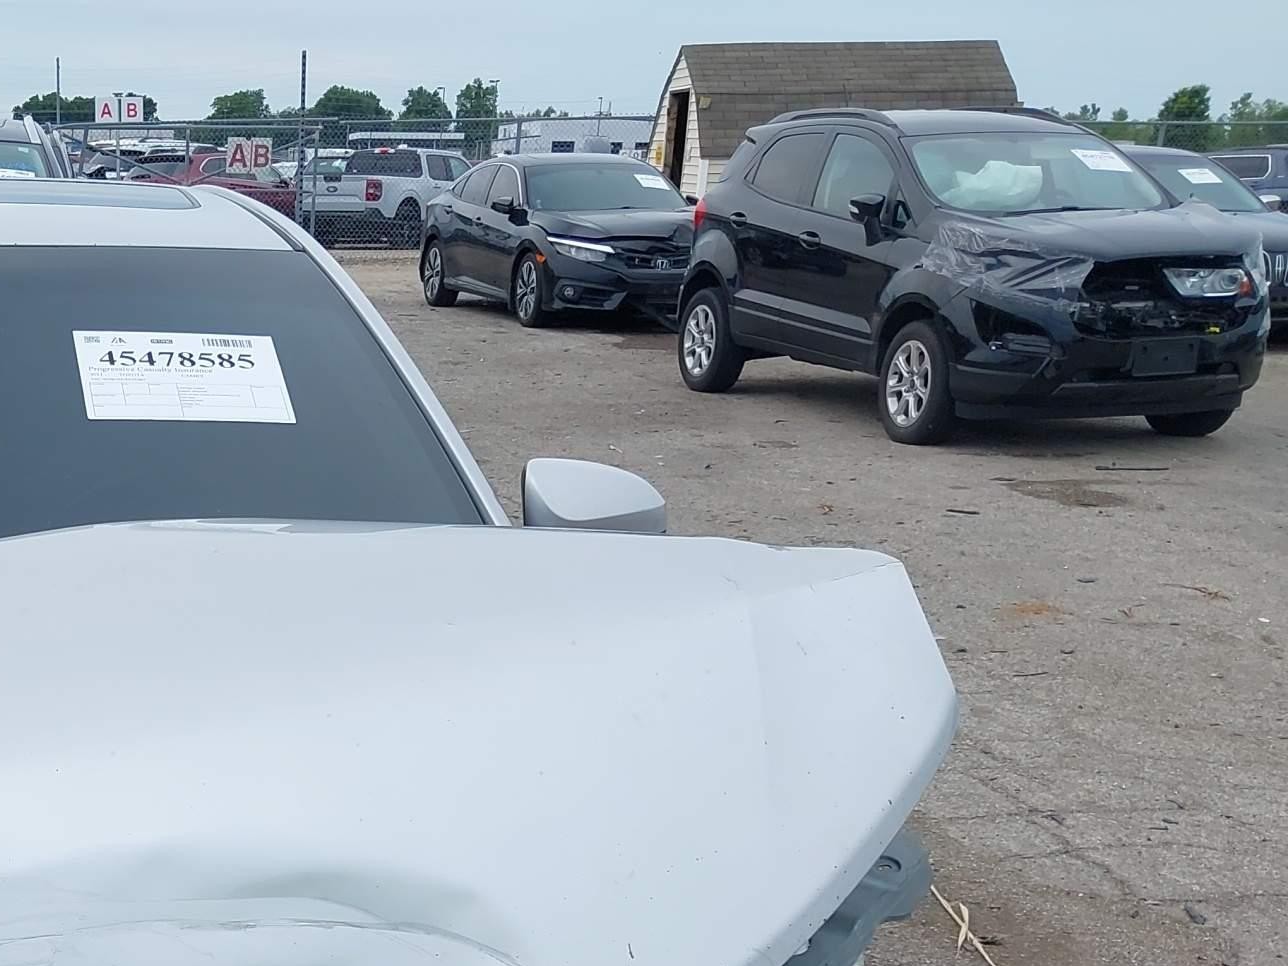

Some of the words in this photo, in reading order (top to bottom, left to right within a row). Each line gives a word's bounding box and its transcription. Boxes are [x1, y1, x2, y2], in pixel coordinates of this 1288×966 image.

[100, 102, 113, 119] A
[127, 102, 138, 118] B
[228, 143, 248, 168] A
[253, 144, 270, 168] B
[99, 350, 255, 370] 45478585
